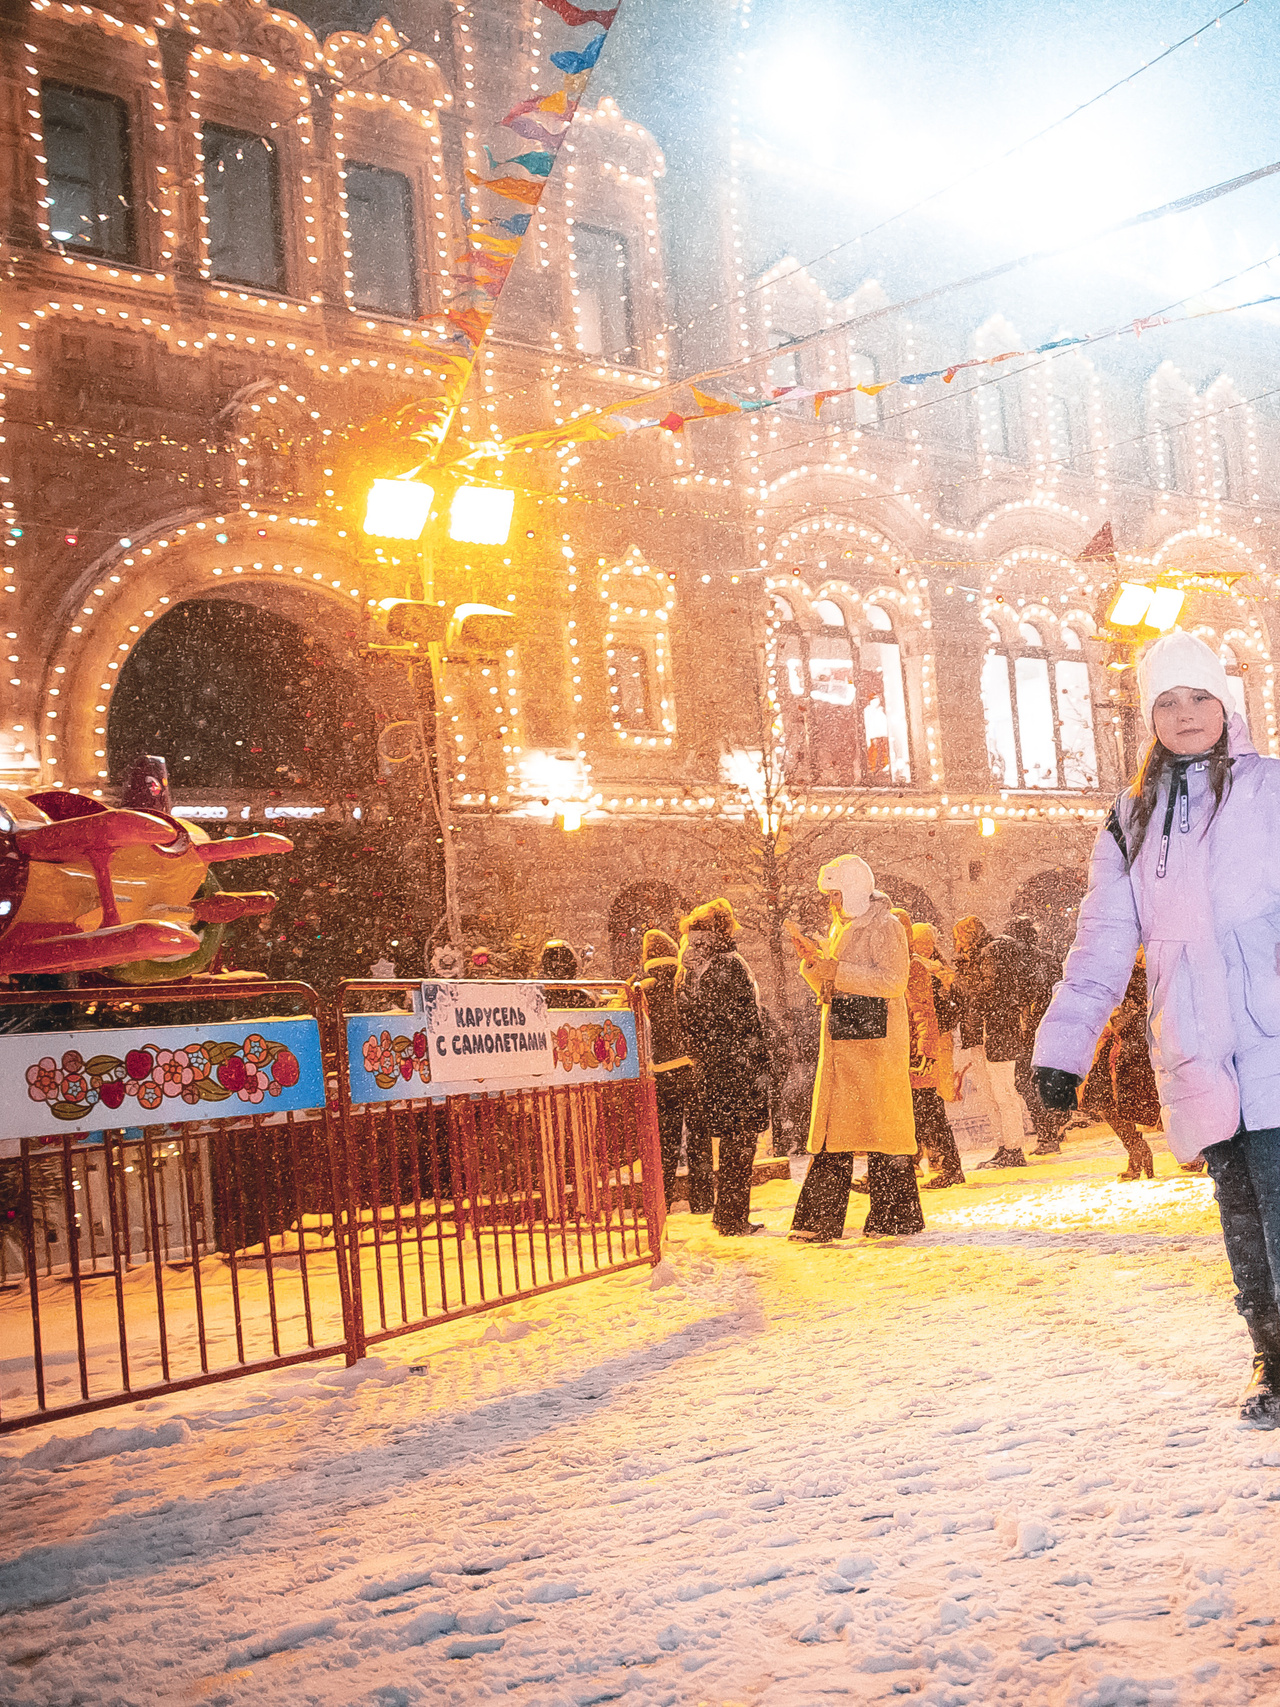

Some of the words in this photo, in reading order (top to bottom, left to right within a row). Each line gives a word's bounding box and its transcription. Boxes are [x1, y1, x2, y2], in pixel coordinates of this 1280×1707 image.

[454, 1006, 526, 1028] КАРУСЕЛЬ
[436, 1035, 447, 1056] С
[451, 1032, 547, 1055] САМОЛЕТАМИ
